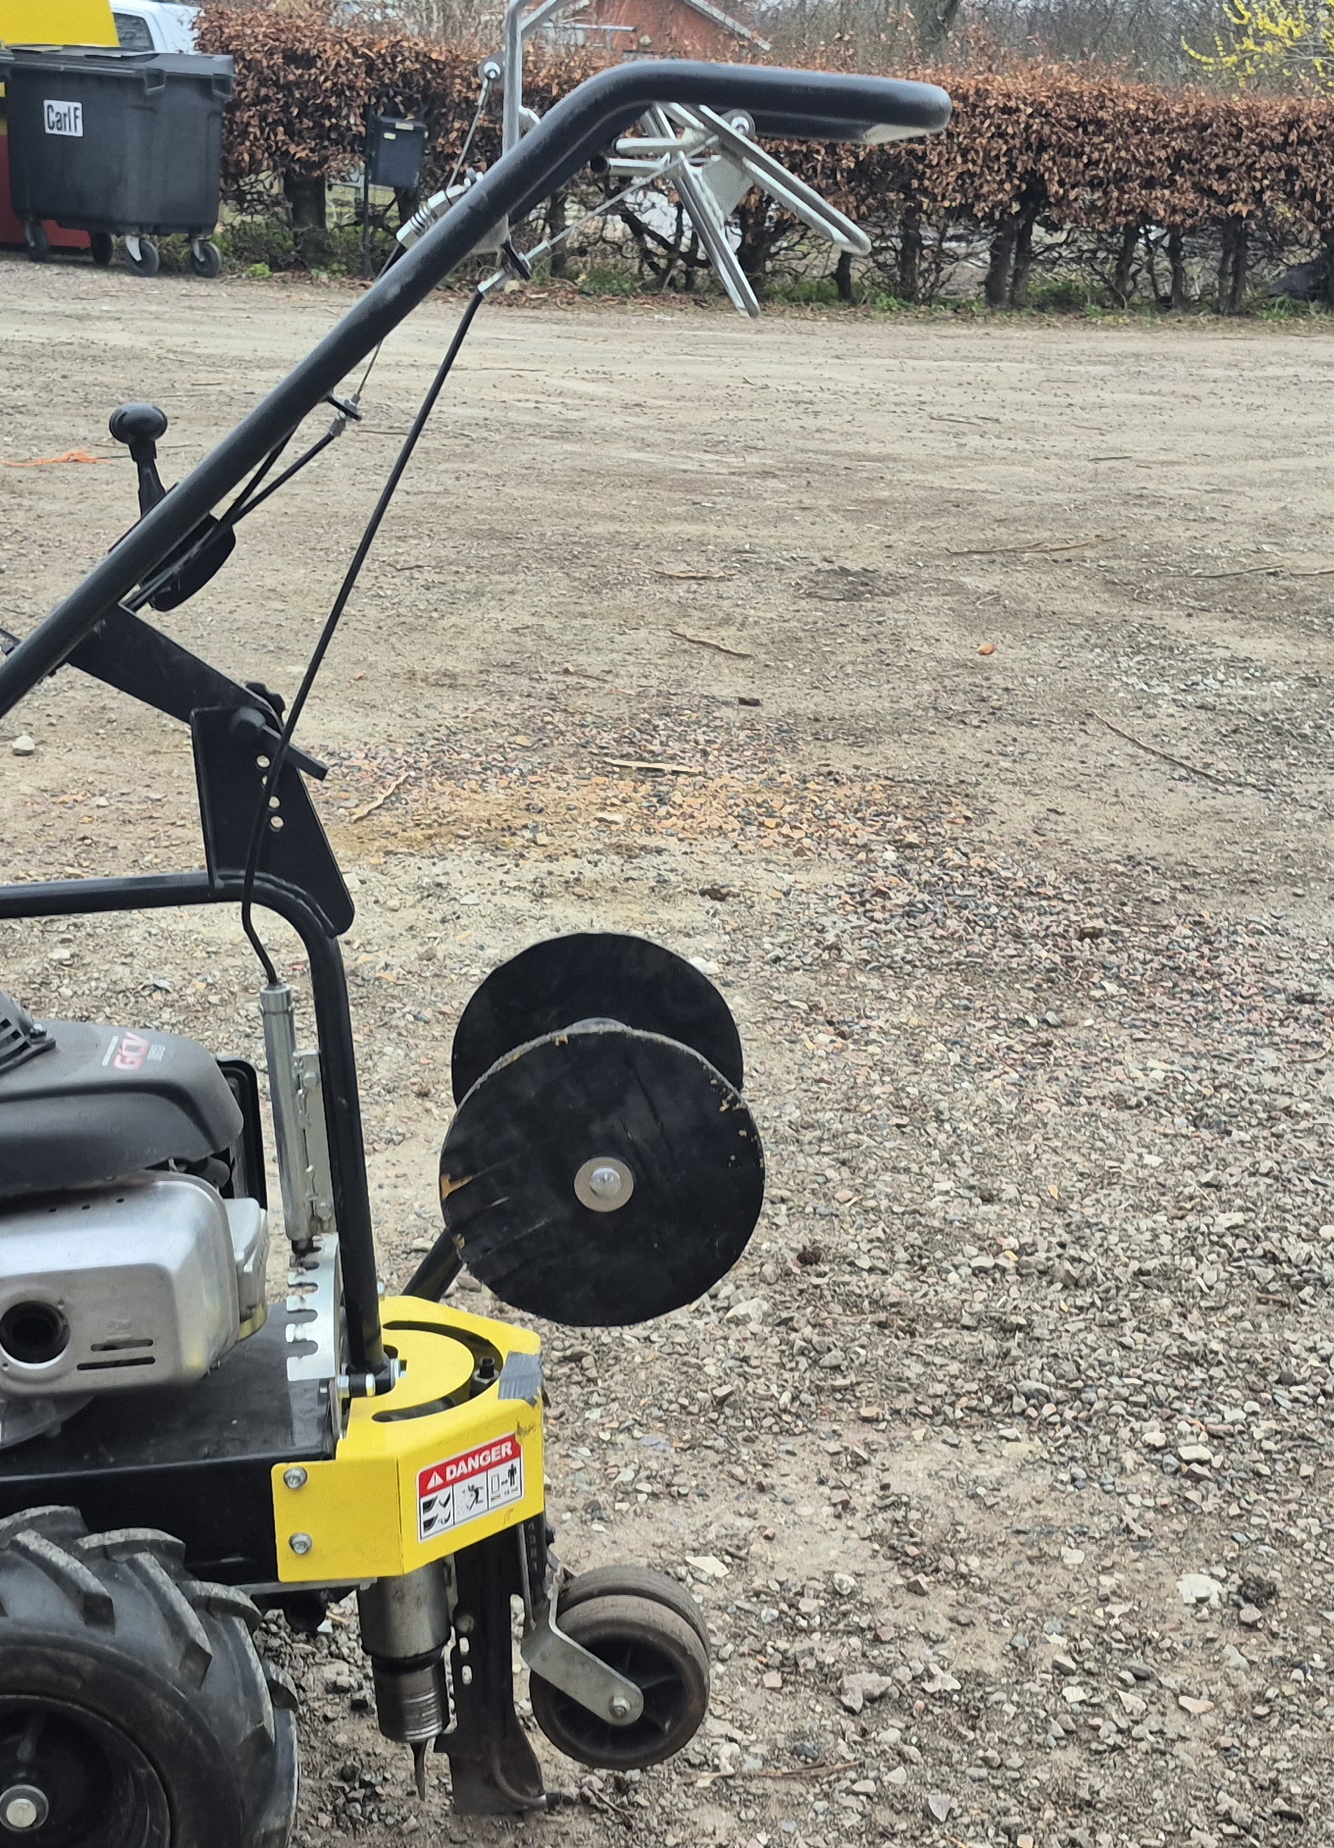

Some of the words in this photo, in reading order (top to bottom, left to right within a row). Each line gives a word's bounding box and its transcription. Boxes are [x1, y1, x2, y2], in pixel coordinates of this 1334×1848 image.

[47, 104, 71, 132] Carl
[73, 106, 80, 133] F
[445, 1441, 513, 1481] DANGER
